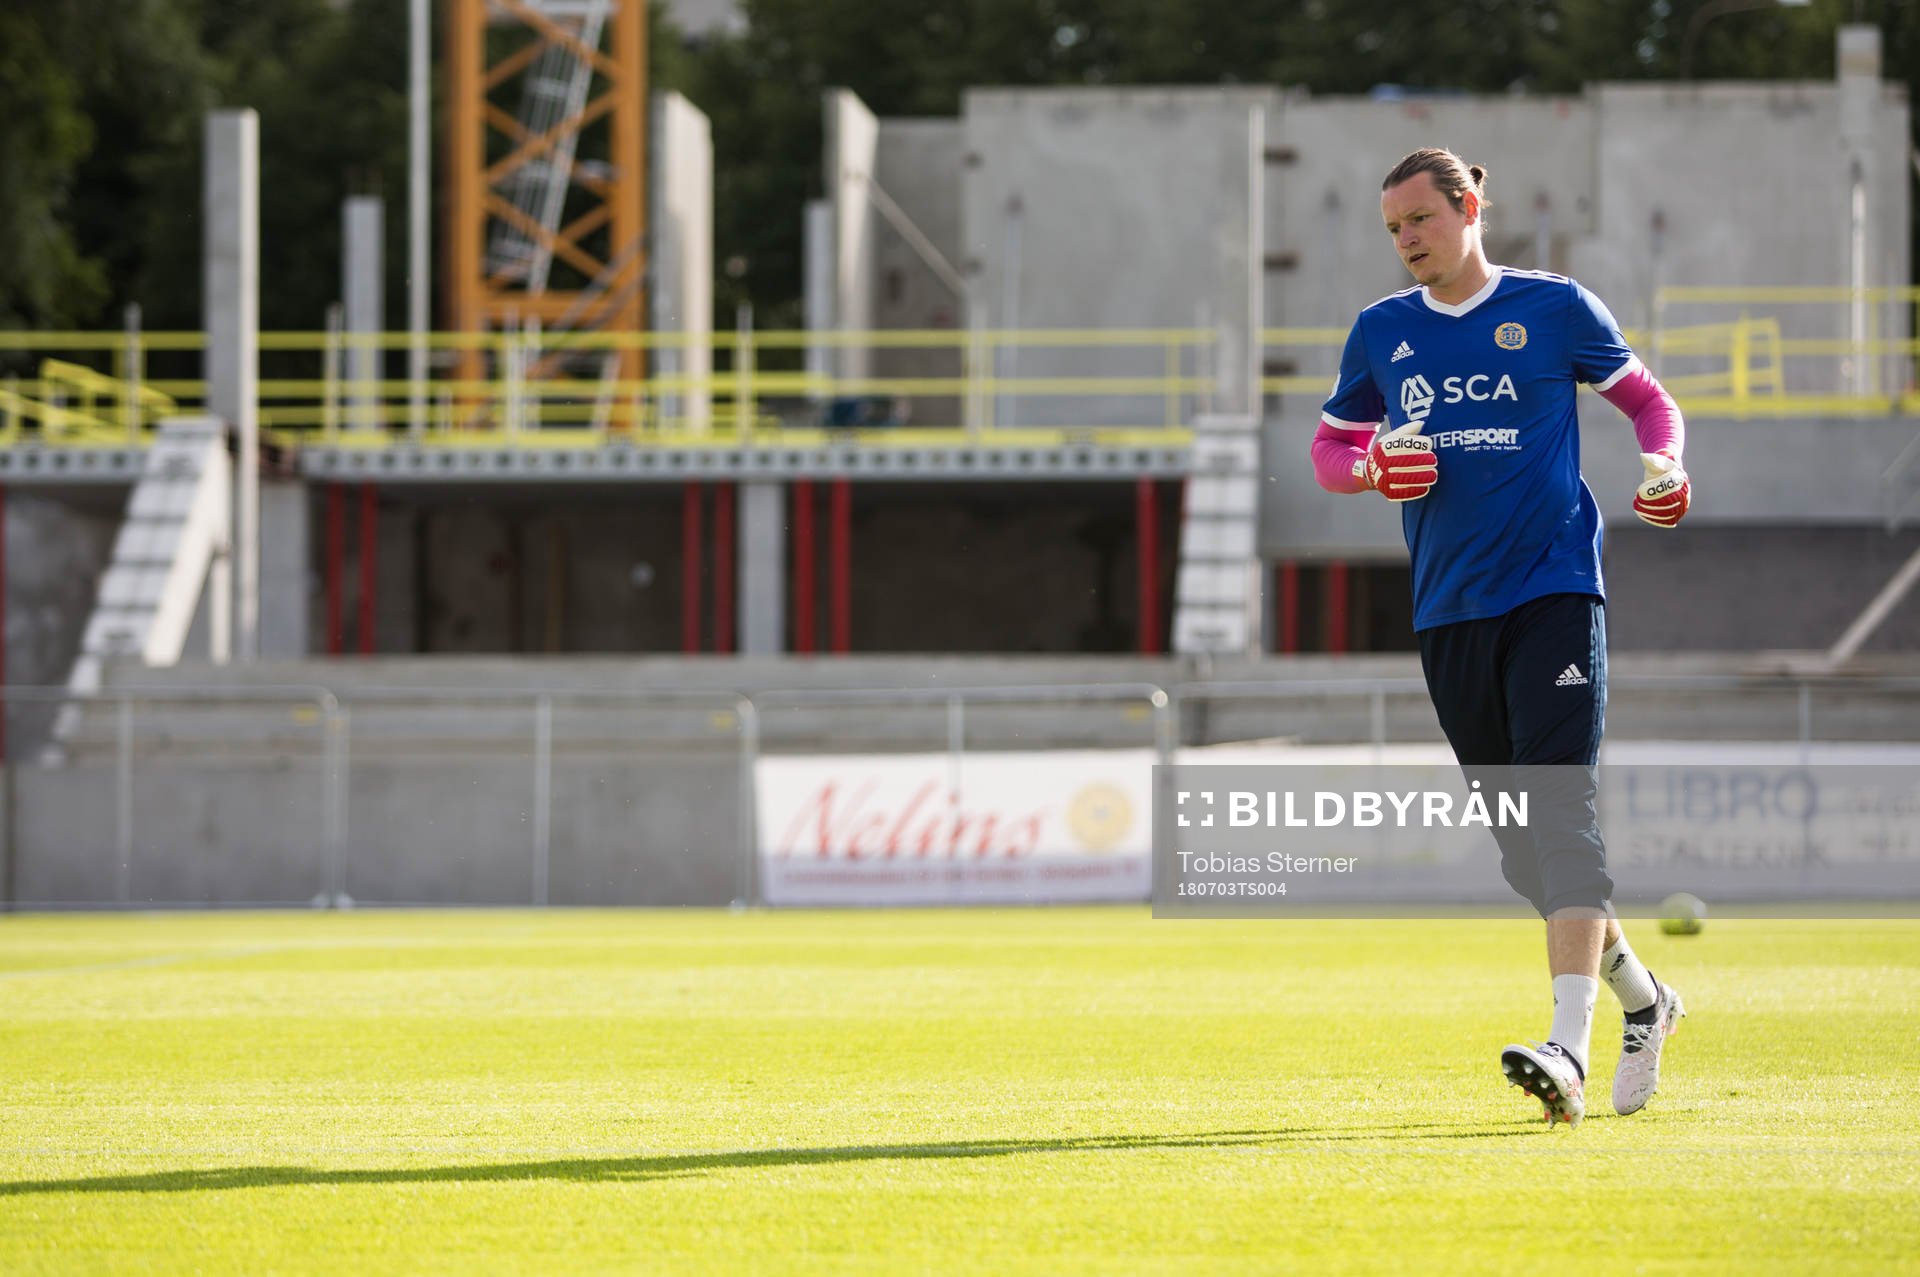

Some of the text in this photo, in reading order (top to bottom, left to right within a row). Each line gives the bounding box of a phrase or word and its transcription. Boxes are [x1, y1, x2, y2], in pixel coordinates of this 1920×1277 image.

[1443, 374, 1518, 403] SCA
[1385, 437, 1428, 451] adidas
[1429, 427, 1519, 450] TERSPORT
[1555, 677, 1588, 687] adidas
